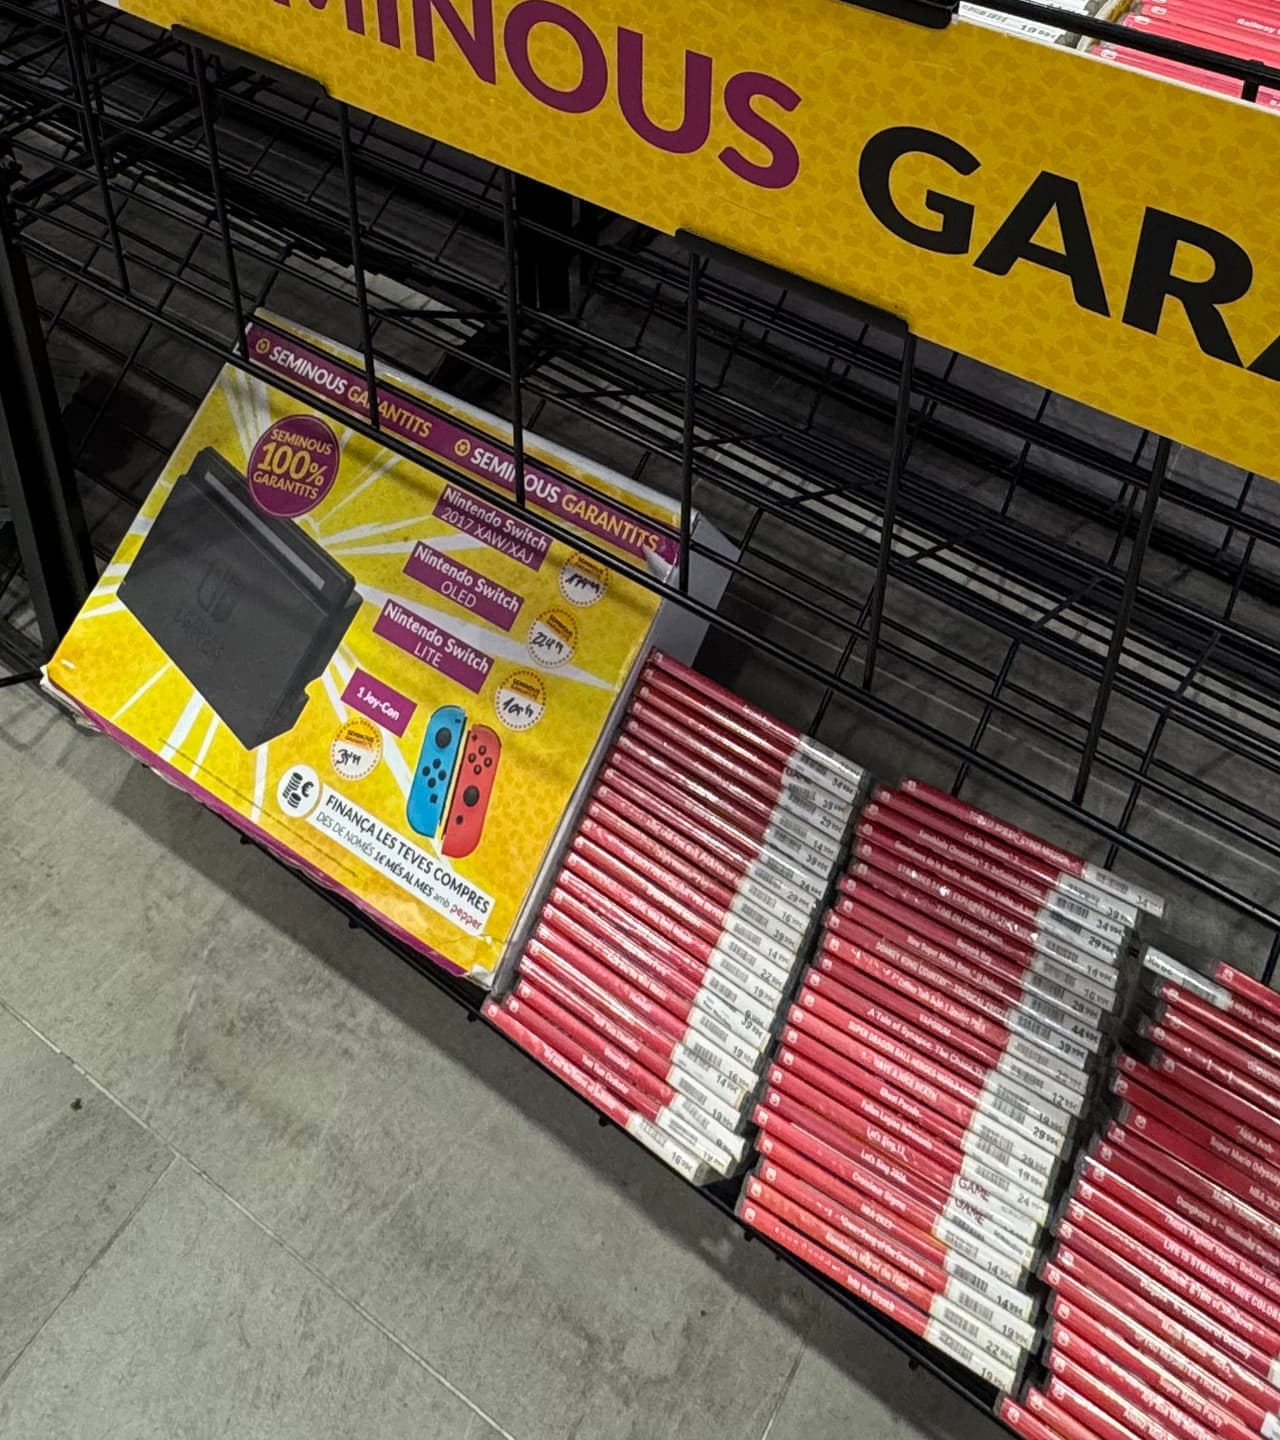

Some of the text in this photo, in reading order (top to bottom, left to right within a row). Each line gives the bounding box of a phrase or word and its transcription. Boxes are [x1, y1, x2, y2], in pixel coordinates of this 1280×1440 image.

[269, 346, 347, 395] SEMINOUS
[259, 442, 324, 486] 100%
[270, 428, 332, 456] SEMINOUS
[252, 471, 319, 500] GARANTITS
[440, 507, 534, 566] 2017 XAW/XAJ
[443, 487, 547, 551] Nintendo Switch
[561, 494, 660, 552] GARANTITS
[415, 544, 474, 586] Nintendo
[475, 577, 520, 612] Switch
[441, 581, 477, 608] OLED
[384, 605, 444, 647] Nintendo
[444, 638, 488, 674] Switch
[414, 643, 443, 668] LITE
[357, 686, 400, 721] 1 Joy-Con
[316, 812, 482, 930] DES DE NOMÉS 1€ MÉS AL MES amb pepper
[326, 795, 490, 913] FINANÇA LES TEVES COMPRES
